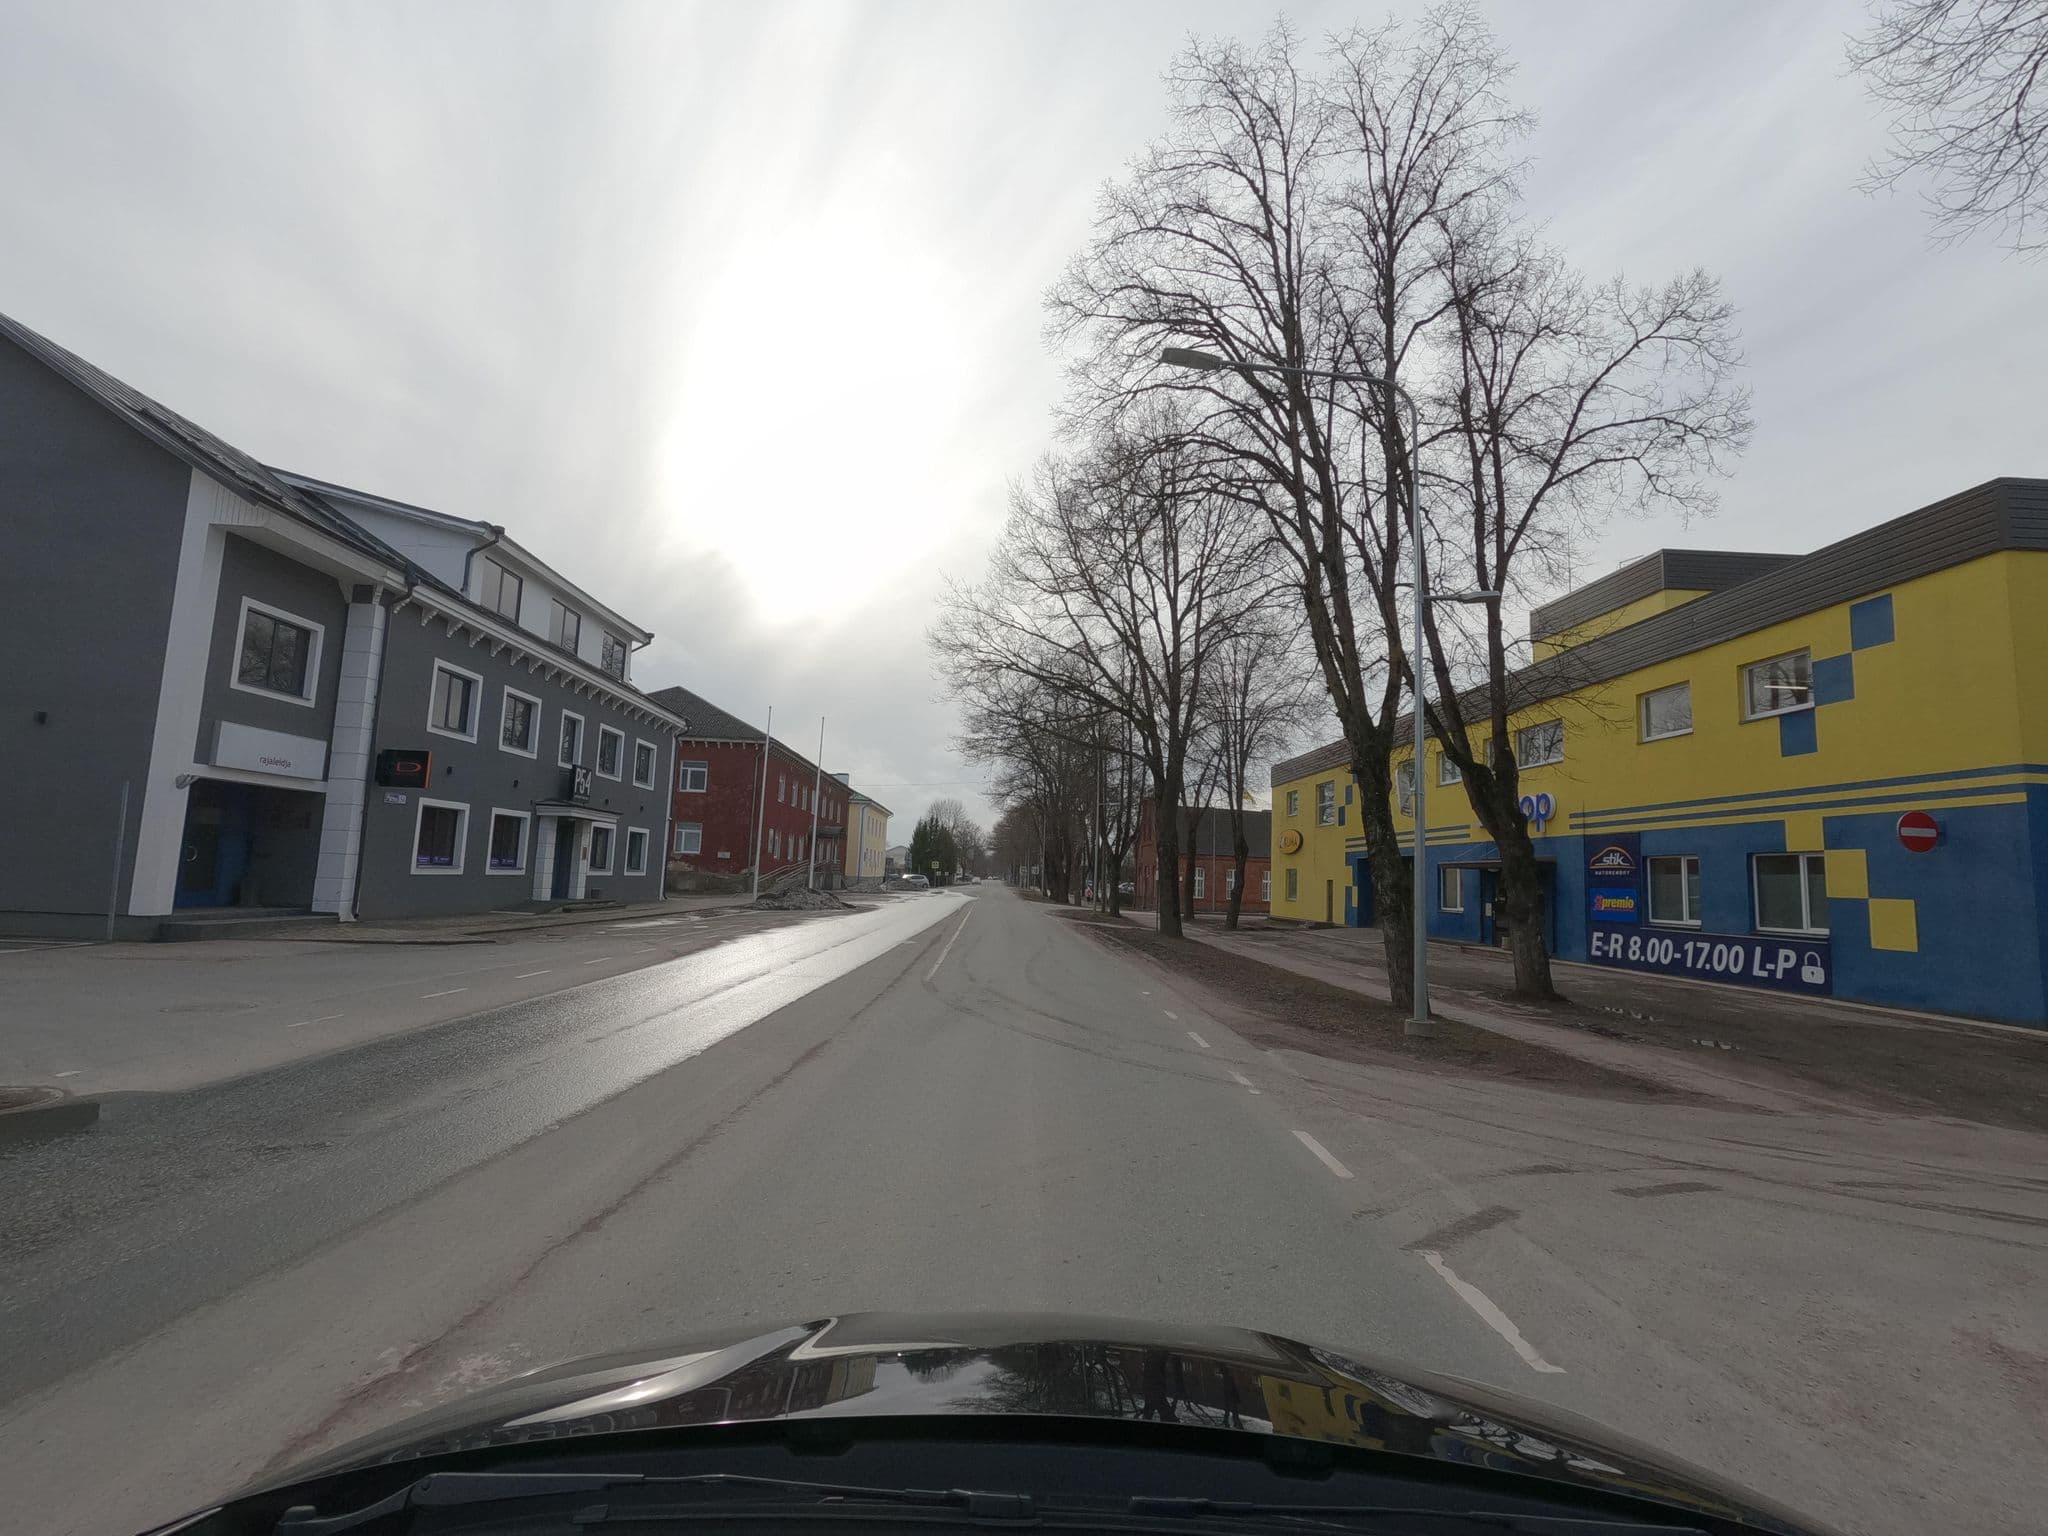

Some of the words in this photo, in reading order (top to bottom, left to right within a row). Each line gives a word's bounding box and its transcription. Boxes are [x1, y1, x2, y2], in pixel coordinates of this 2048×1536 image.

[574, 767, 592, 796] P54
[1602, 852, 1626, 866] stik
[1602, 896, 1635, 910] premio
[1591, 931, 1623, 959] E-R
[1628, 936, 1745, 974] 8.00-17.00
[1752, 946, 1797, 980] L-P
